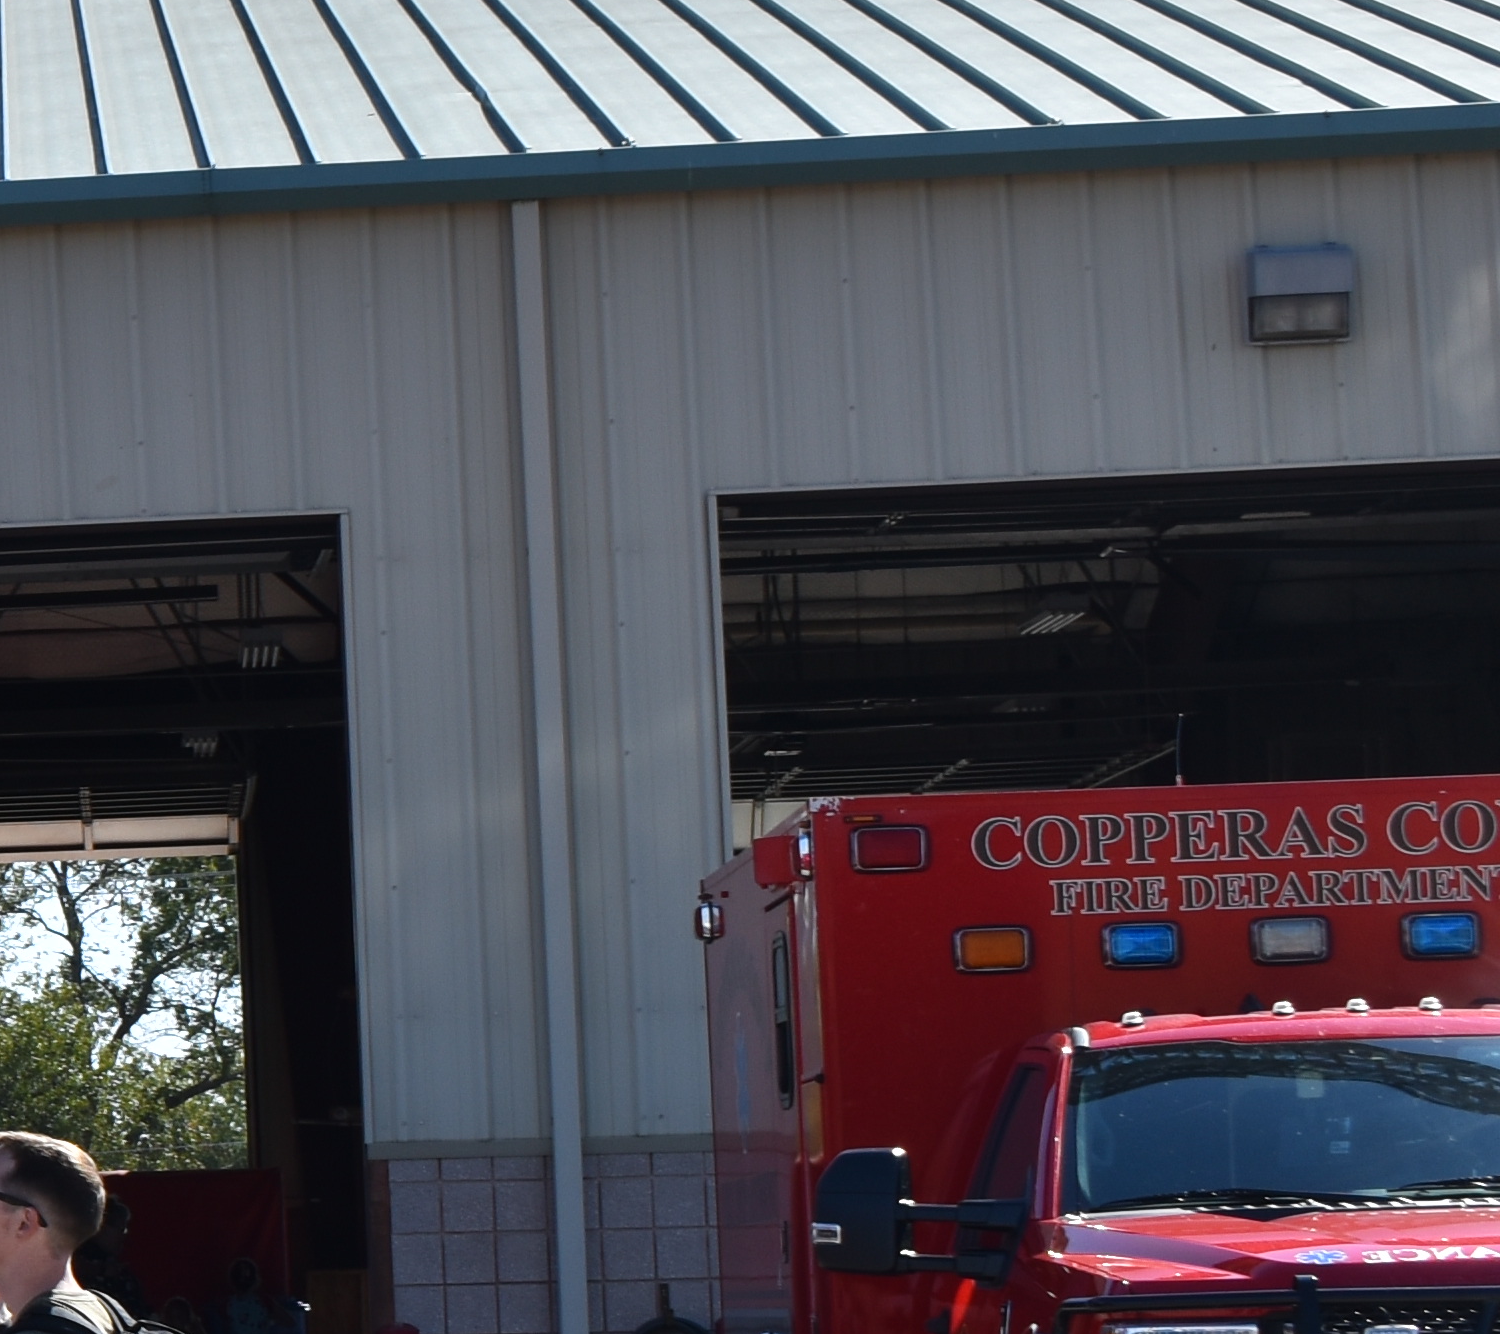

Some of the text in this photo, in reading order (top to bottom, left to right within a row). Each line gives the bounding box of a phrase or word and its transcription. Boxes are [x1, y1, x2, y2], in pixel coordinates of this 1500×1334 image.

[970, 798, 1500, 871] COPPERAS CO
[1049, 874, 1169, 917] FIRE
